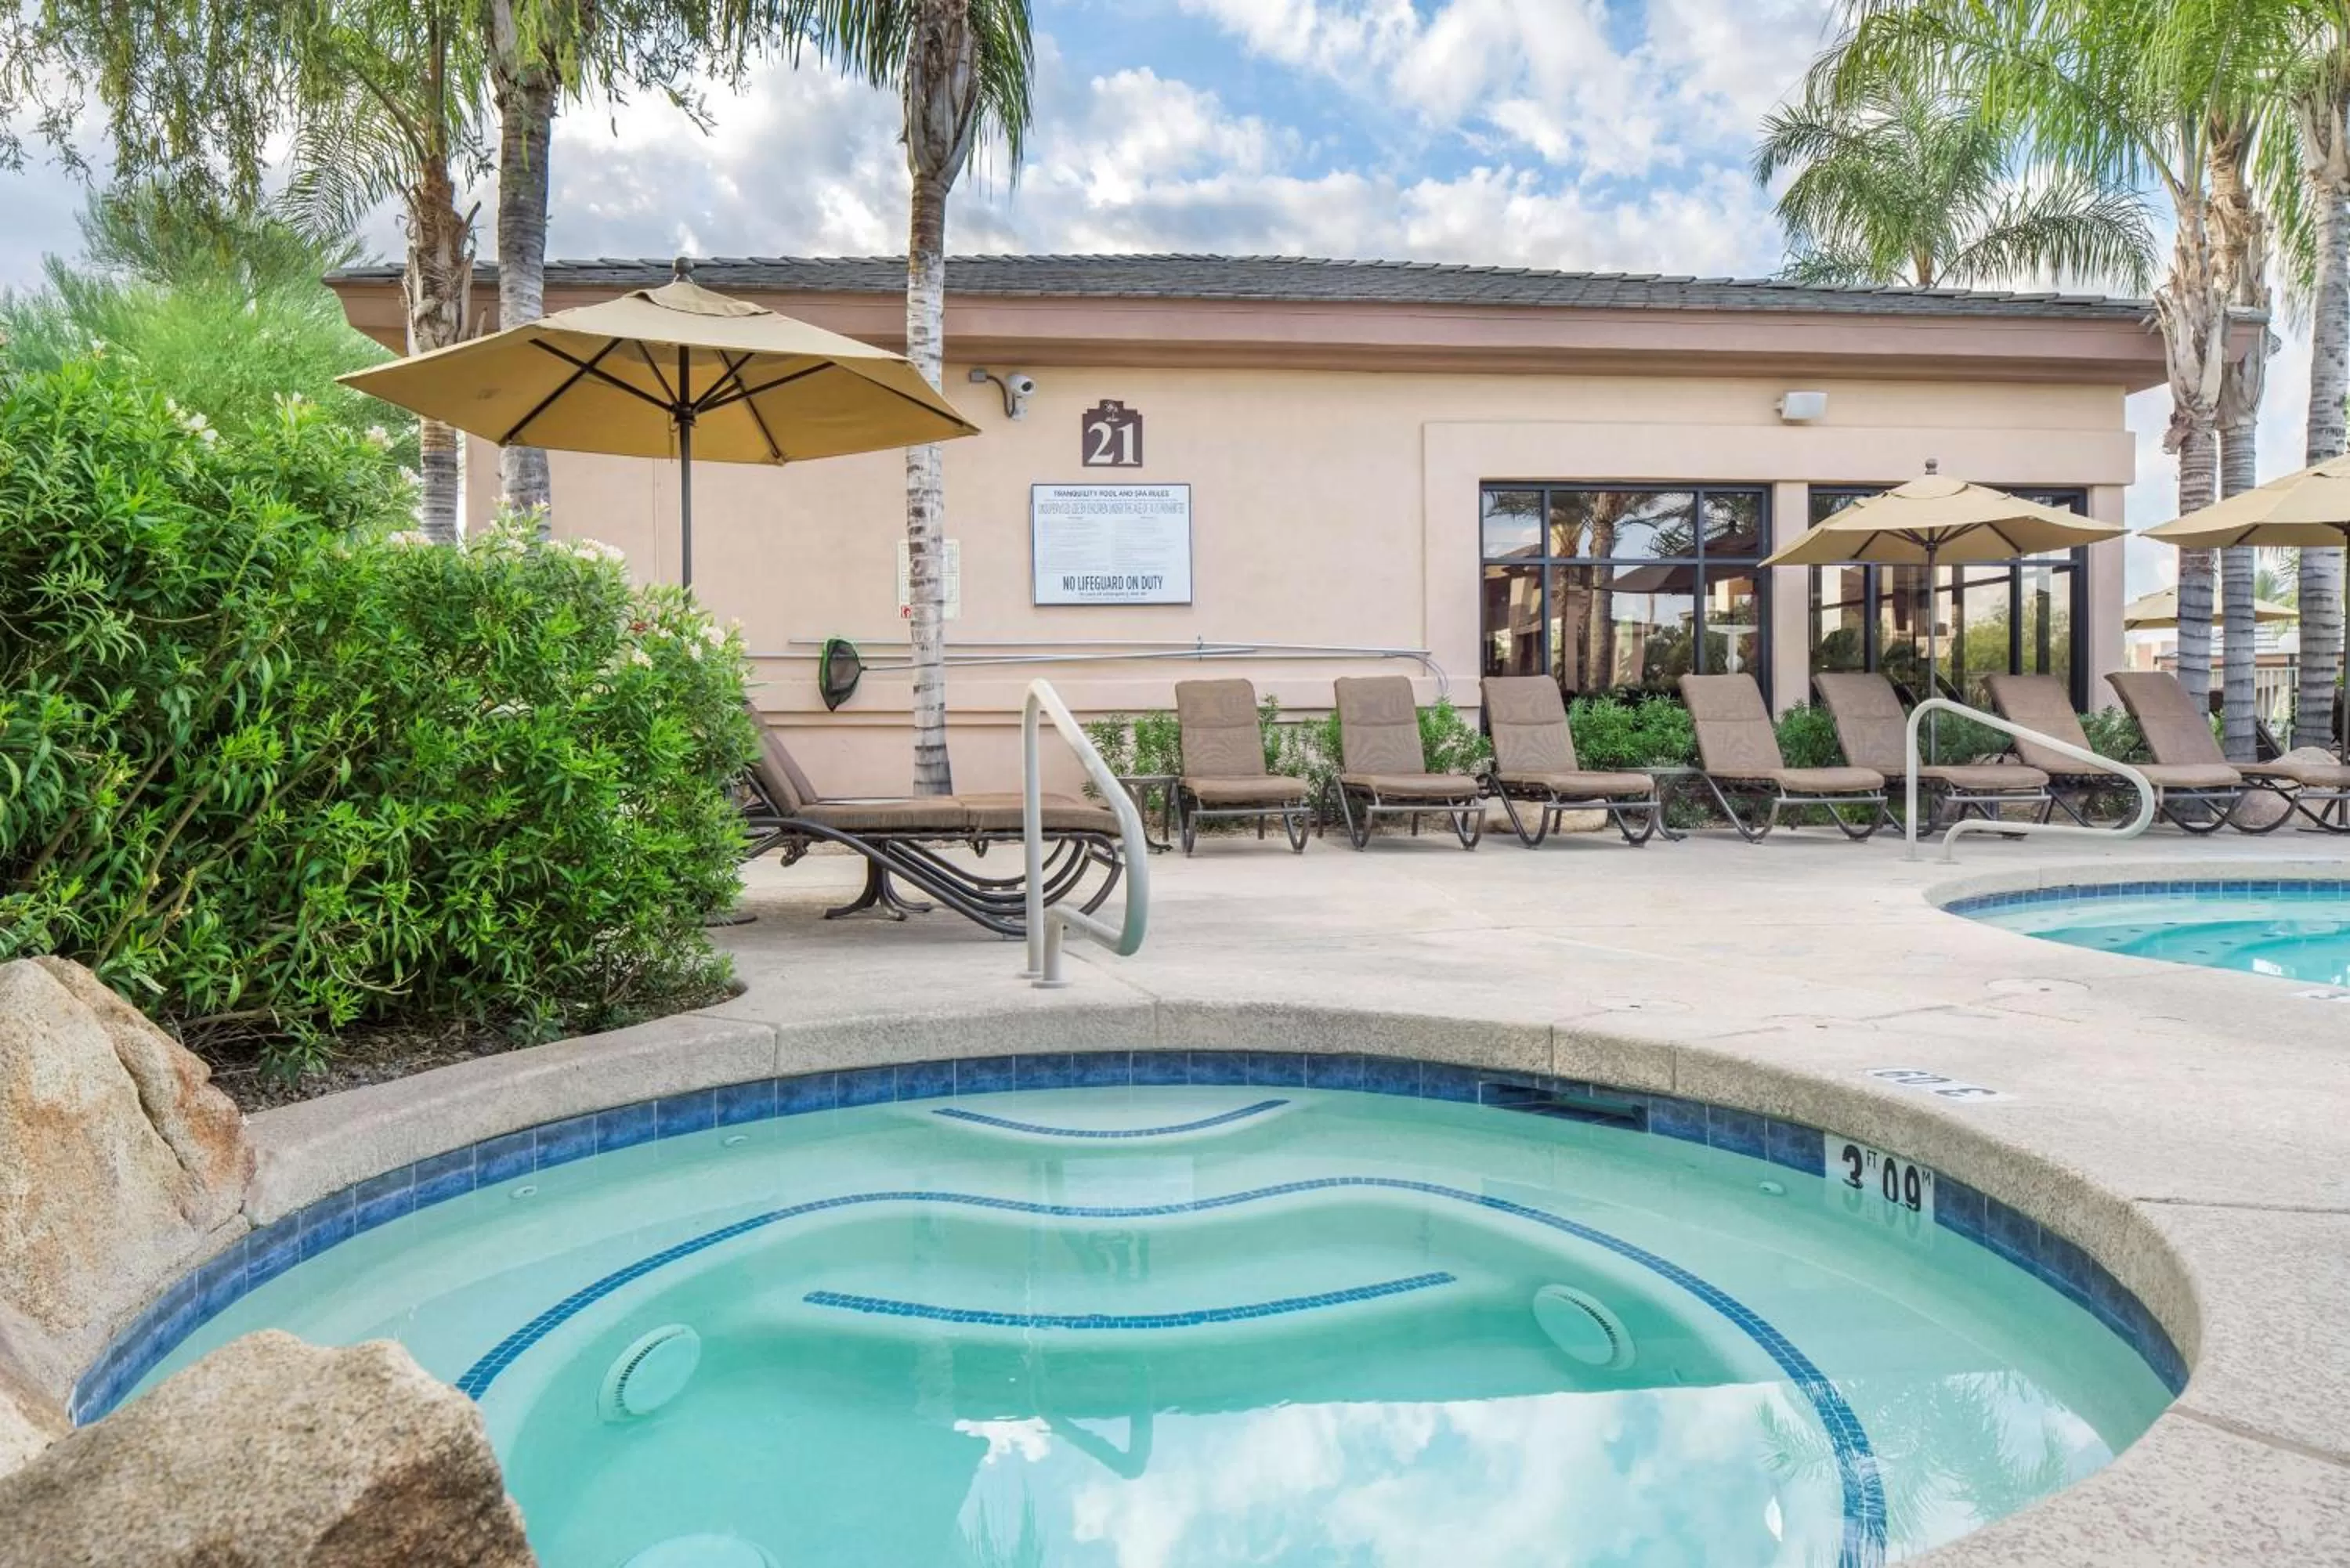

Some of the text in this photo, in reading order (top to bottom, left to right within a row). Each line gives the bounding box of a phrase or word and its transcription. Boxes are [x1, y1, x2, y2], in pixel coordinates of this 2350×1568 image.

[1087, 421, 1139, 464] 21
[1063, 576, 1163, 591] NO LIFEGUARD ON DUTY
[1842, 1144, 1864, 1190] 3
[1867, 1150, 1877, 1169] FT
[1922, 1171, 1931, 1186] M
